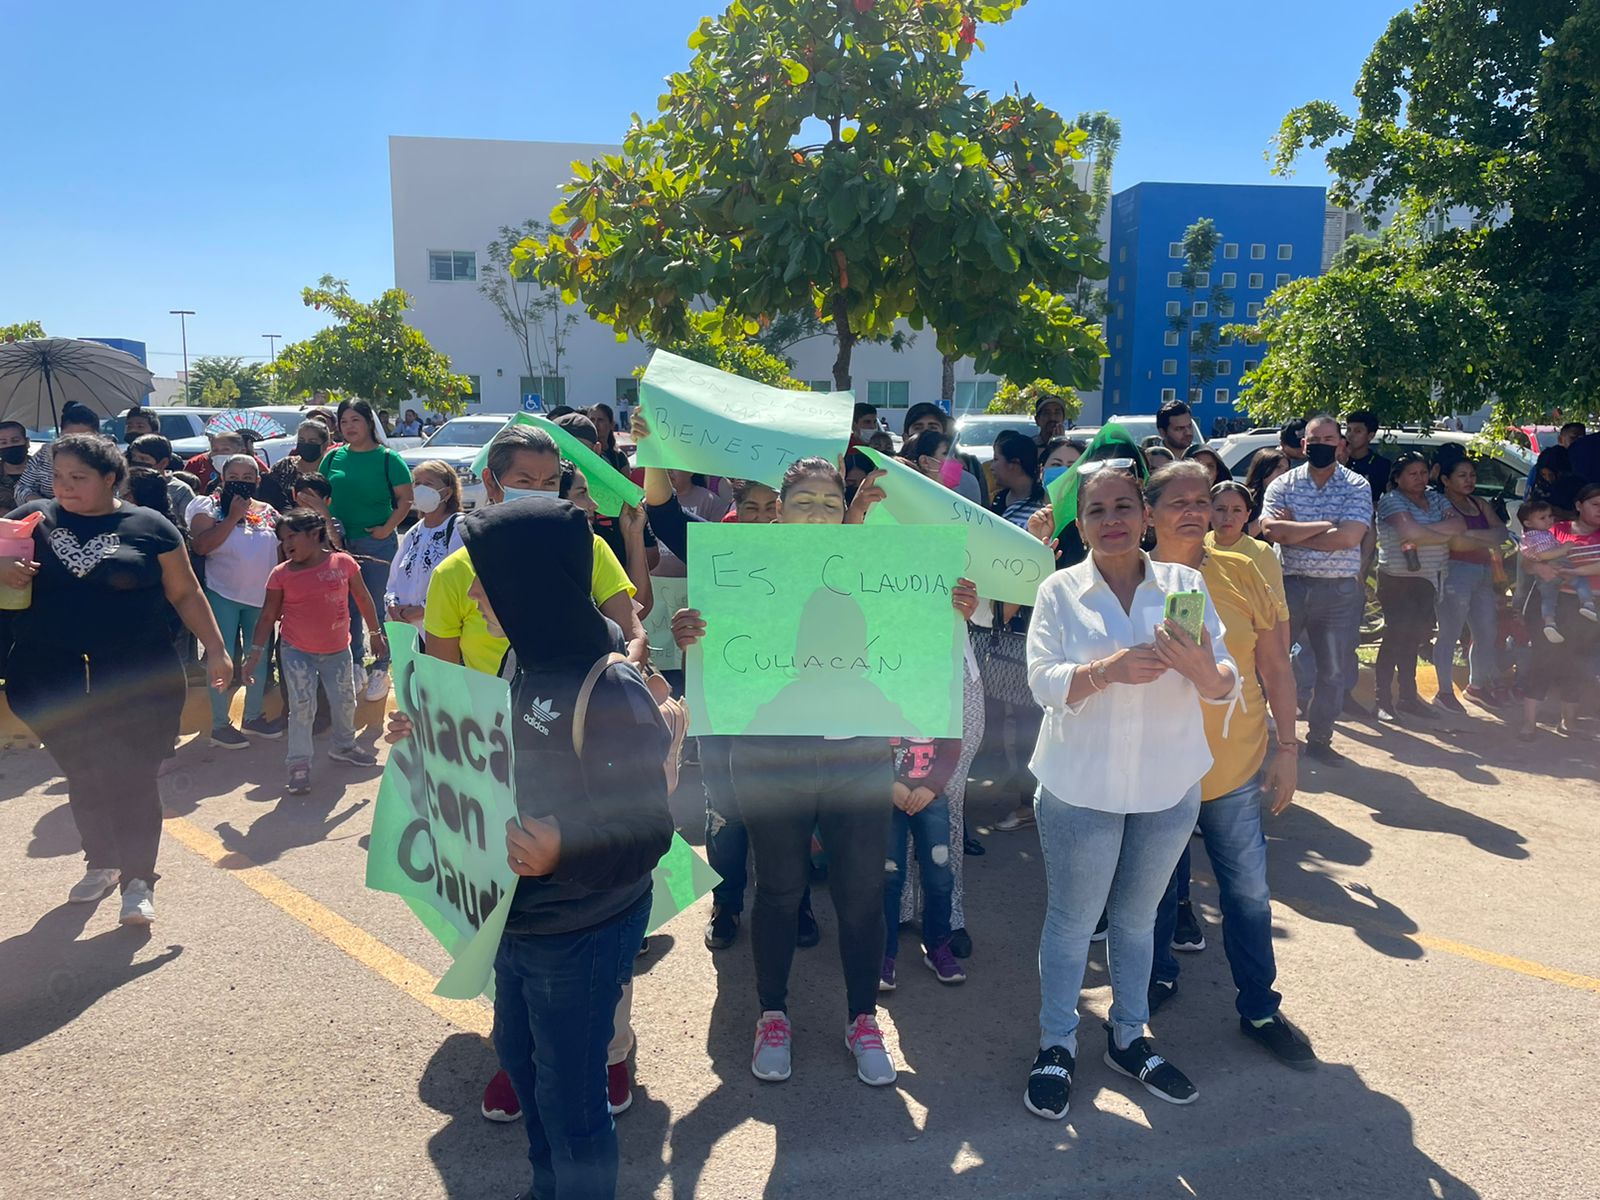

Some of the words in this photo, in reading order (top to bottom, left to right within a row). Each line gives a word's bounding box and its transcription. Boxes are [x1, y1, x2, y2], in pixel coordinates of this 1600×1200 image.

[671, 366, 727, 394] CON
[752, 391, 836, 418] CLAUDIA
[655, 407, 795, 466] BIENEST
[992, 558, 1041, 582] CON
[523, 713, 550, 736] adidas
[397, 817, 505, 930] Claud
[1041, 1065, 1069, 1079] NIKE
